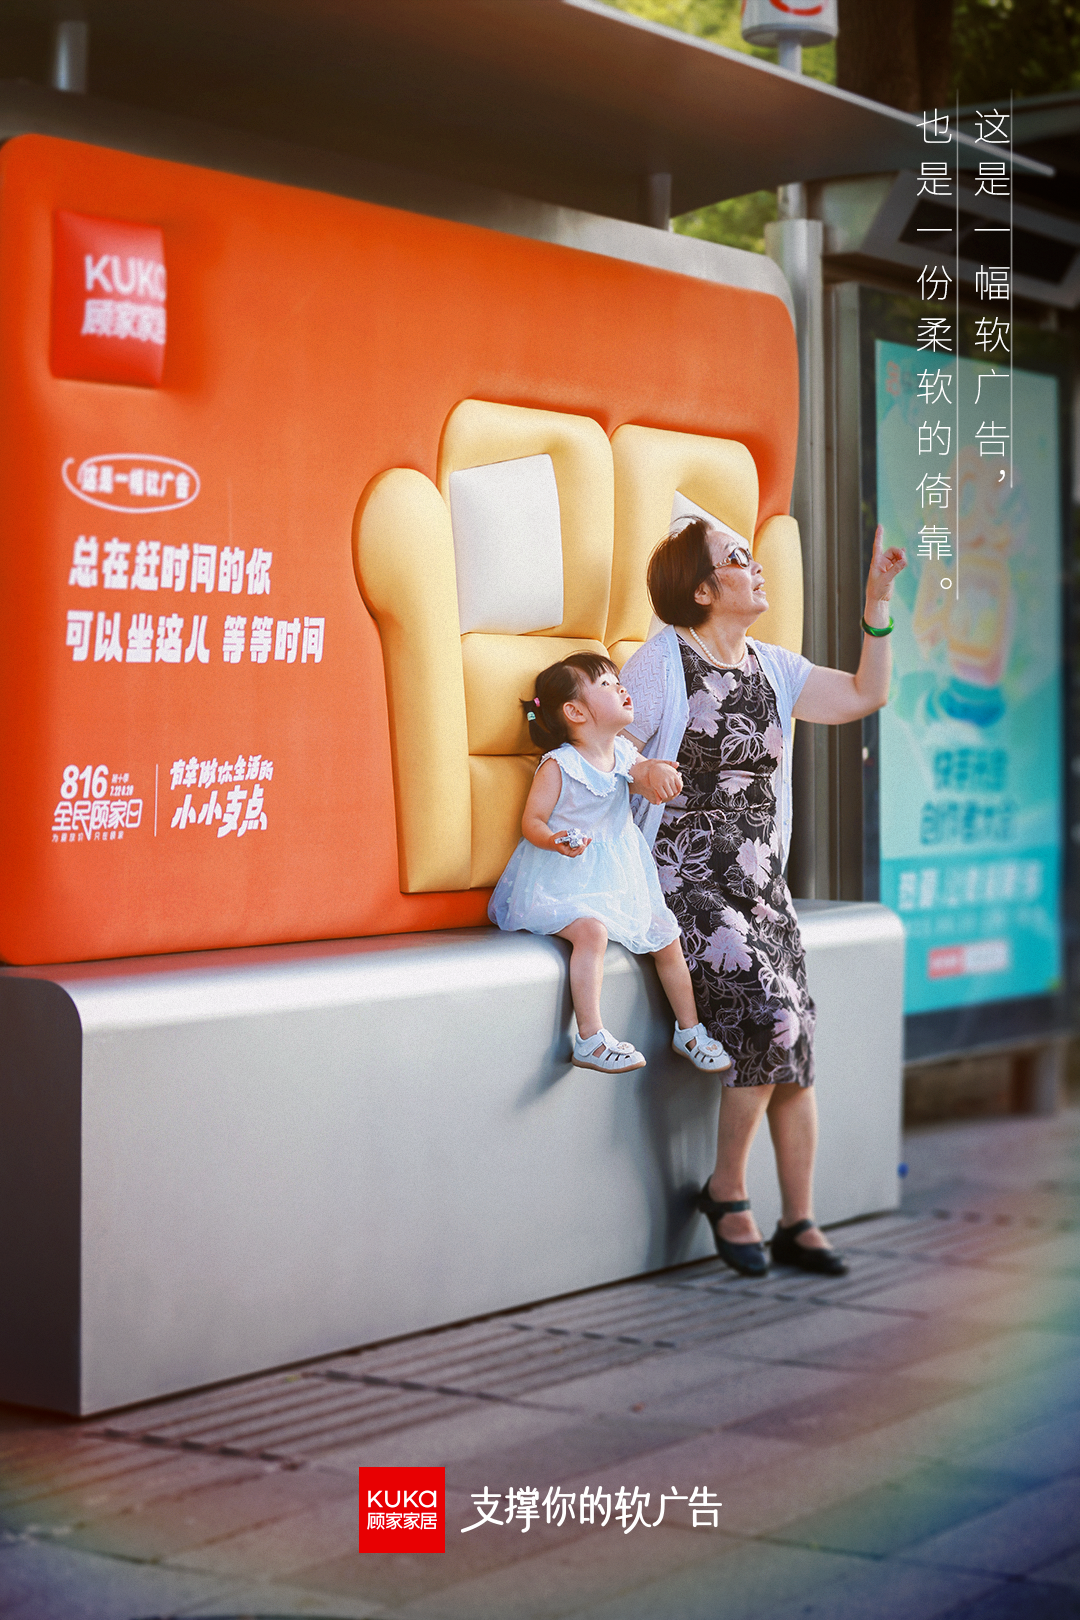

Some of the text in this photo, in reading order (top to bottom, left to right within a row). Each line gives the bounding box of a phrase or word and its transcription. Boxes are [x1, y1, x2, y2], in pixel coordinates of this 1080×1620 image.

[68, 534, 273, 595] 总在赶时间的你
[65, 610, 326, 664] 可以坐这儿 等等时间
[60, 764, 109, 799] 816
[51, 798, 143, 841] 全民顾家日
[170, 783, 268, 839] 小小支点
